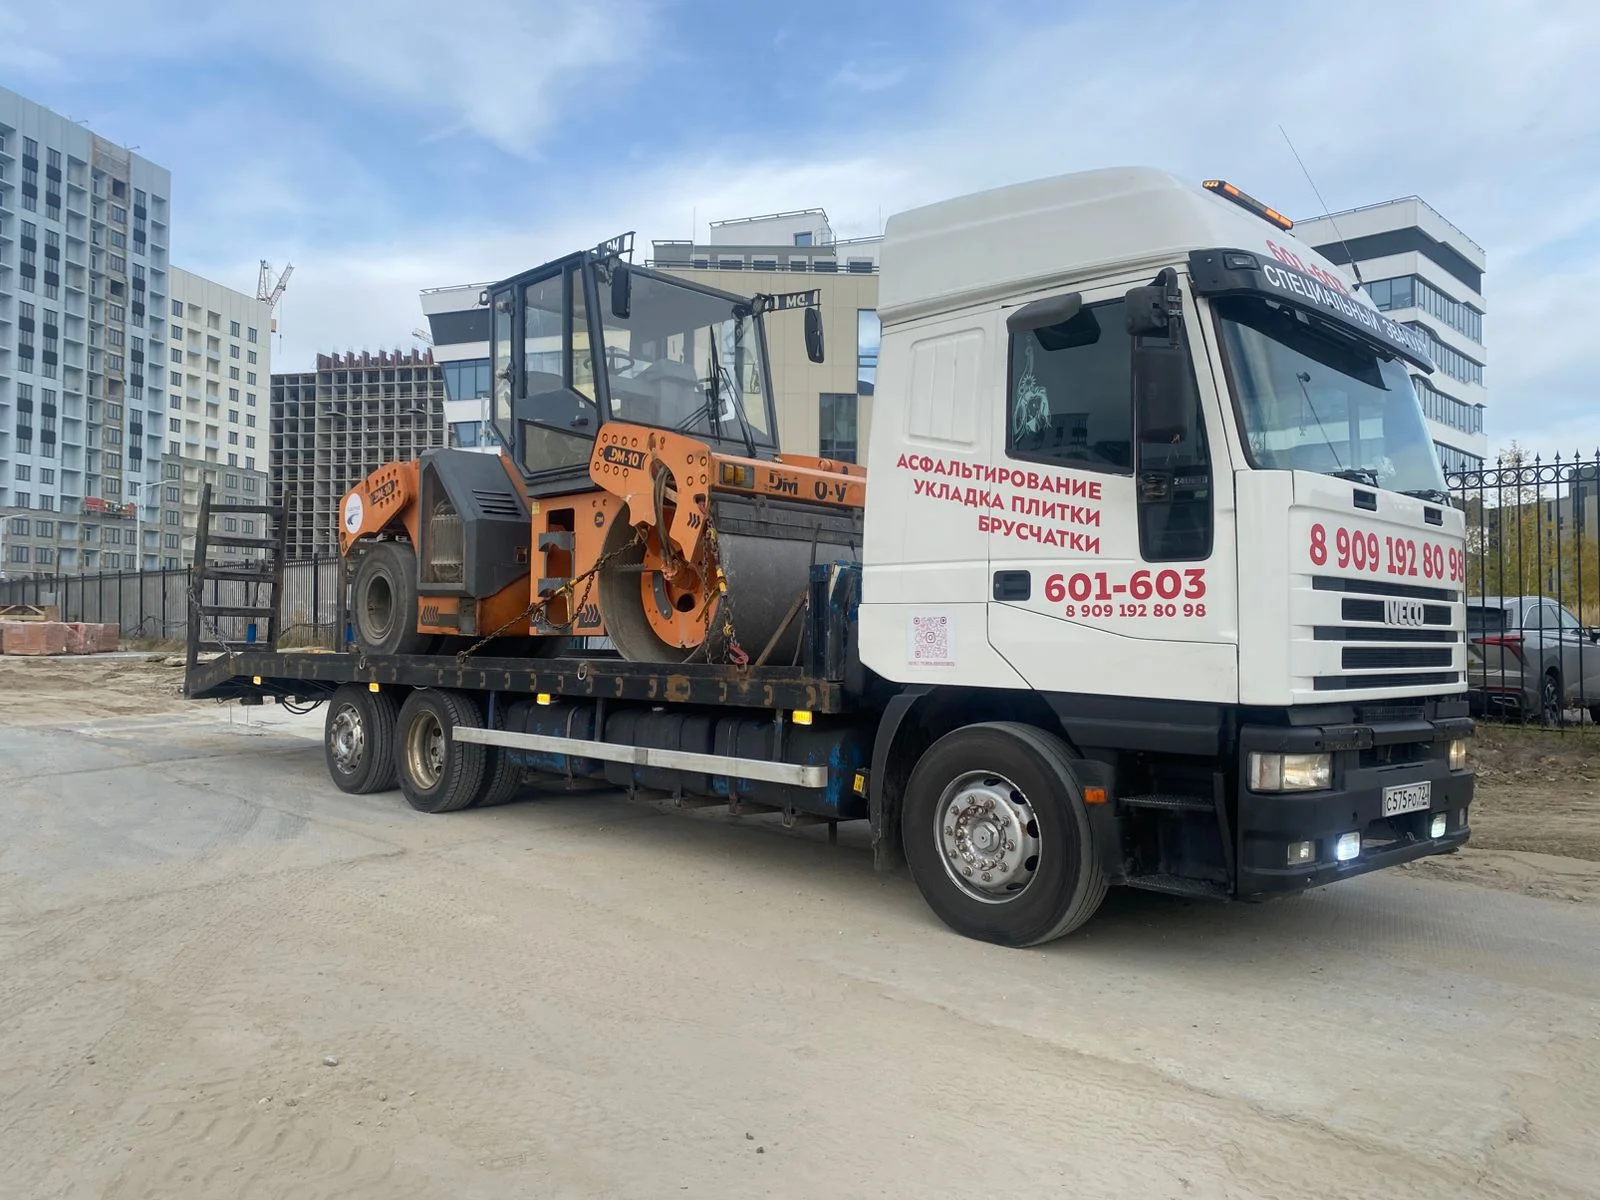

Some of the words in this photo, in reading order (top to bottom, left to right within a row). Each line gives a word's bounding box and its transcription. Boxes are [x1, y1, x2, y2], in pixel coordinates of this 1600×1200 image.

[896, 453, 1102, 500] АСФАЛЬТИРОВАНИЕ
[913, 478, 1005, 510] УКЛАДКА
[1011, 495, 1101, 527] ПЛИТКИ
[978, 515, 1101, 555] БРУСЧАТКИ
[1309, 523, 1327, 566] 8
[1336, 527, 1380, 572] 909
[1386, 536, 1418, 576] 192
[1423, 542, 1444, 580] 80
[1448, 547, 1464, 583] 98
[1044, 568, 1207, 602] 601-603
[1065, 604, 1076, 618] 8
[1081, 604, 1114, 618] 909
[1119, 604, 1148, 618] 192
[1153, 604, 1177, 618] 80
[1183, 604, 1207, 618] 98
[1384, 600, 1424, 626] IVECO
